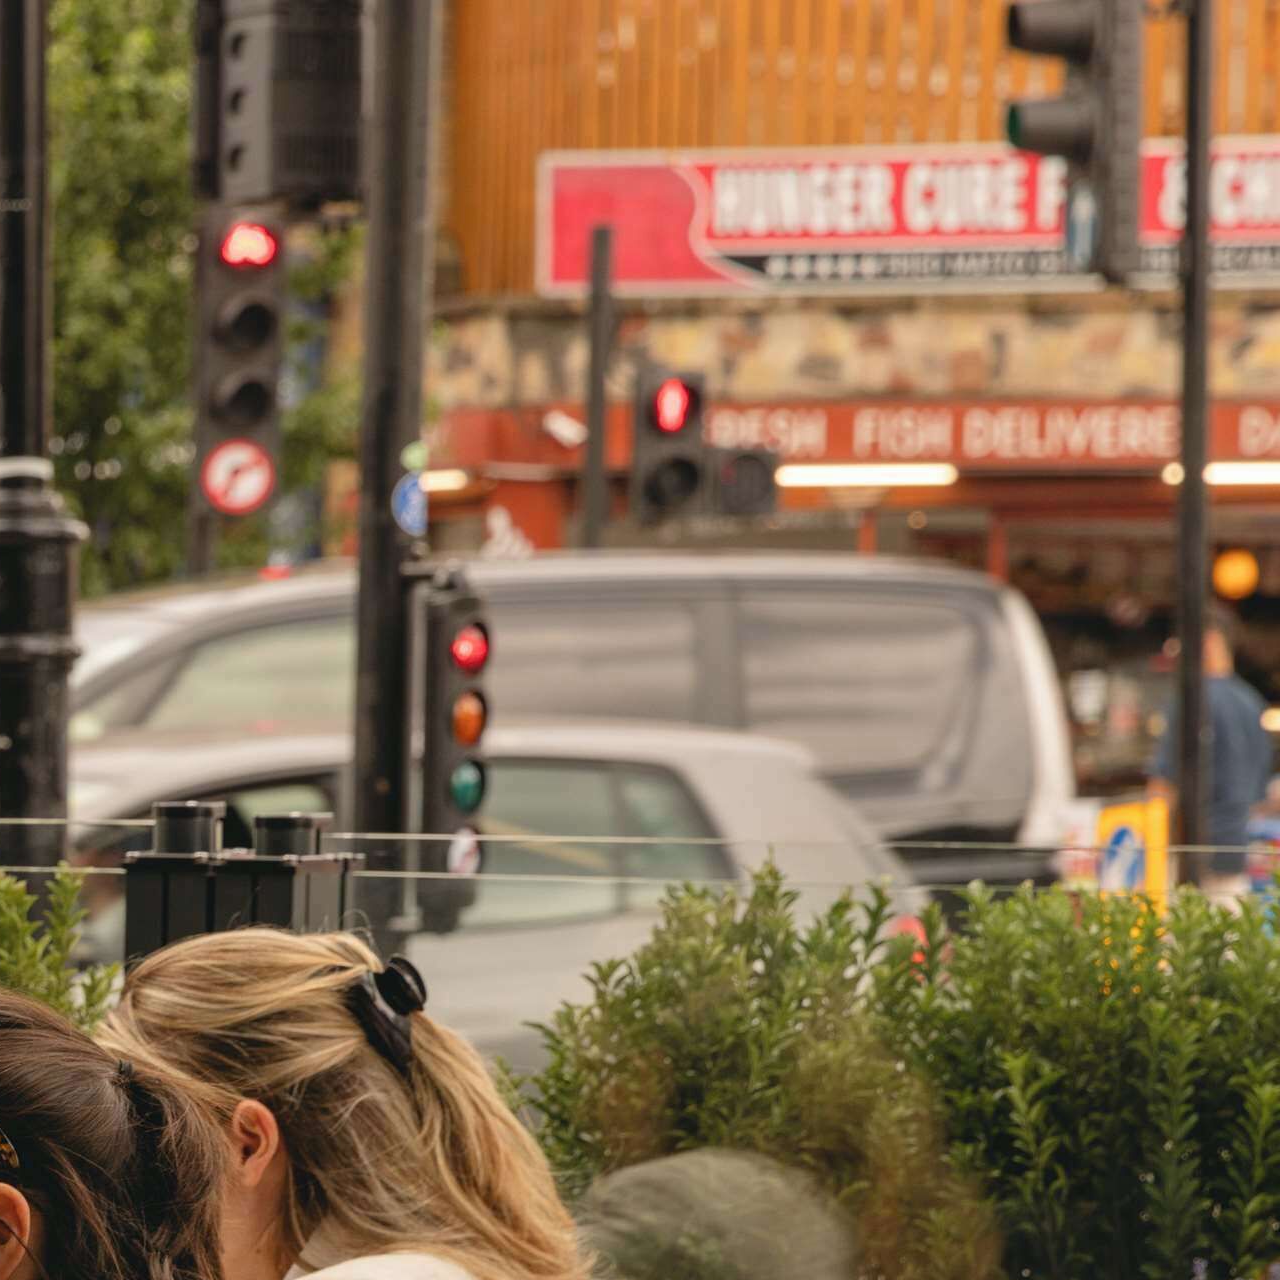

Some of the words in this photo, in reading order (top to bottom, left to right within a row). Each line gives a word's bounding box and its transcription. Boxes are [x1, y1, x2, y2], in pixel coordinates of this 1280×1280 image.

[712, 163, 896, 236] HUNGER
[902, 157, 1028, 233] CURE
[707, 408, 828, 458] RESH
[853, 406, 953, 458] FISH
[962, 405, 1182, 458] DELIVERE
